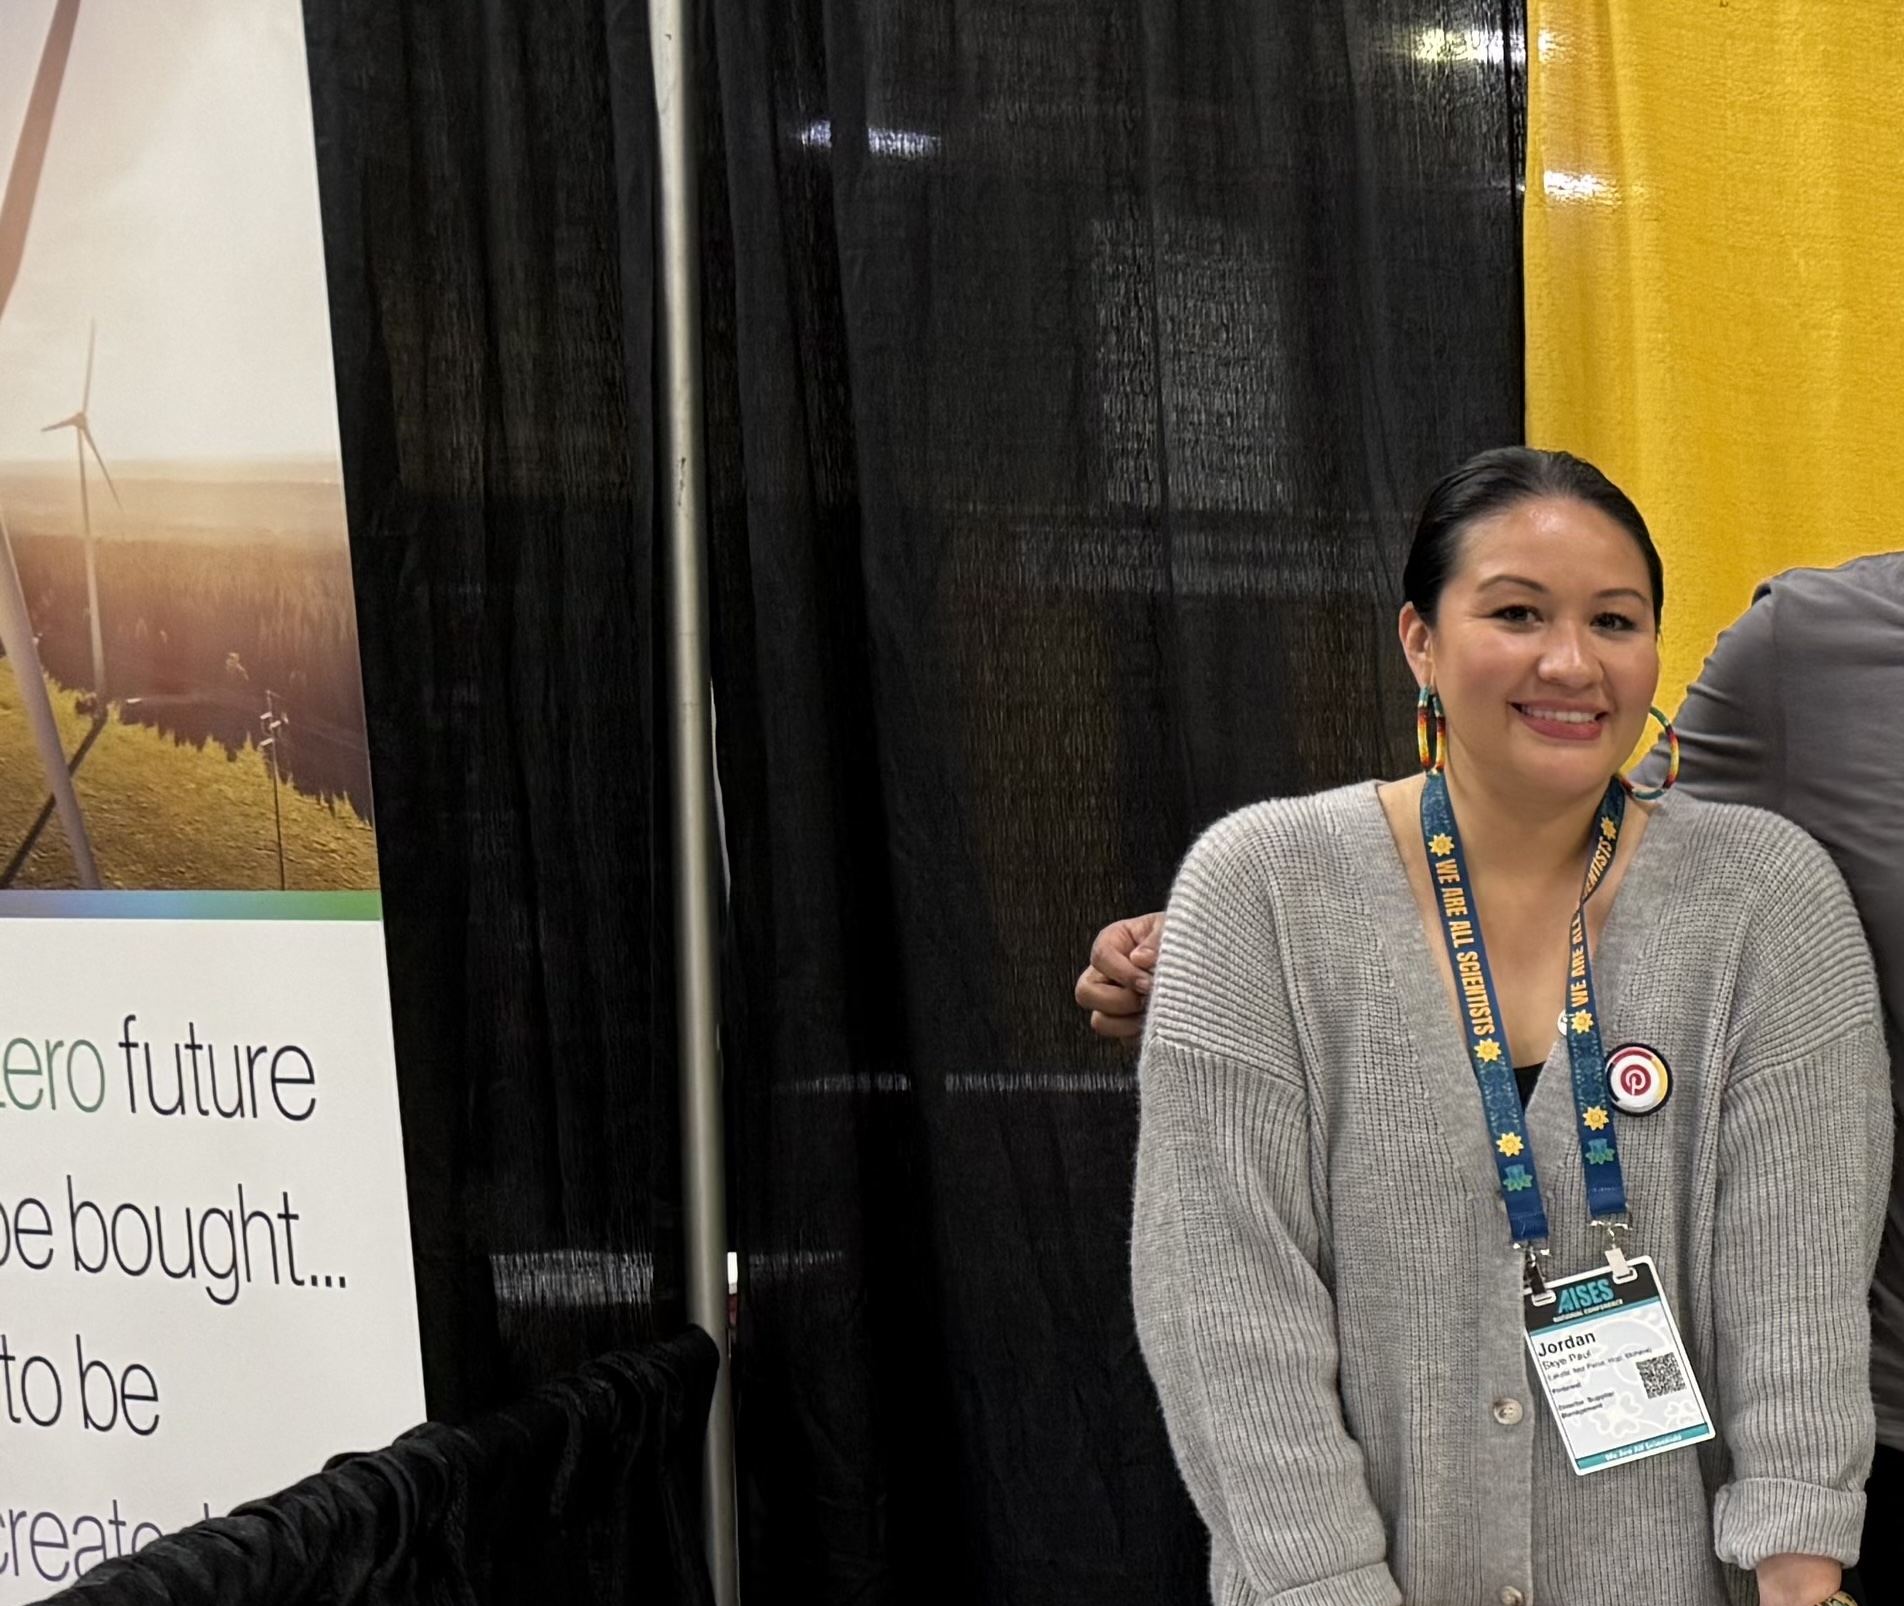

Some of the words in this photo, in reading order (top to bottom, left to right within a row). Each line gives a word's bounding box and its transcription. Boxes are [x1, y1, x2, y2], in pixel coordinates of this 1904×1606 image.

[1435, 858, 1461, 885] WE
[1441, 887, 1468, 917] ARE
[1448, 920, 1475, 949] ALL
[1570, 945, 1585, 978] ARE
[1456, 951, 1496, 1036] SCIENTISTS
[1571, 980, 1589, 1008] WE
[0, 1037, 105, 1113] ero
[119, 1015, 317, 1121] future
[0, 1197, 53, 1270] e
[66, 1174, 347, 1305] bought...
[1558, 1279, 1615, 1314] AISES
[1538, 1332, 1596, 1357] Jordan
[76, 1334, 160, 1436] be
